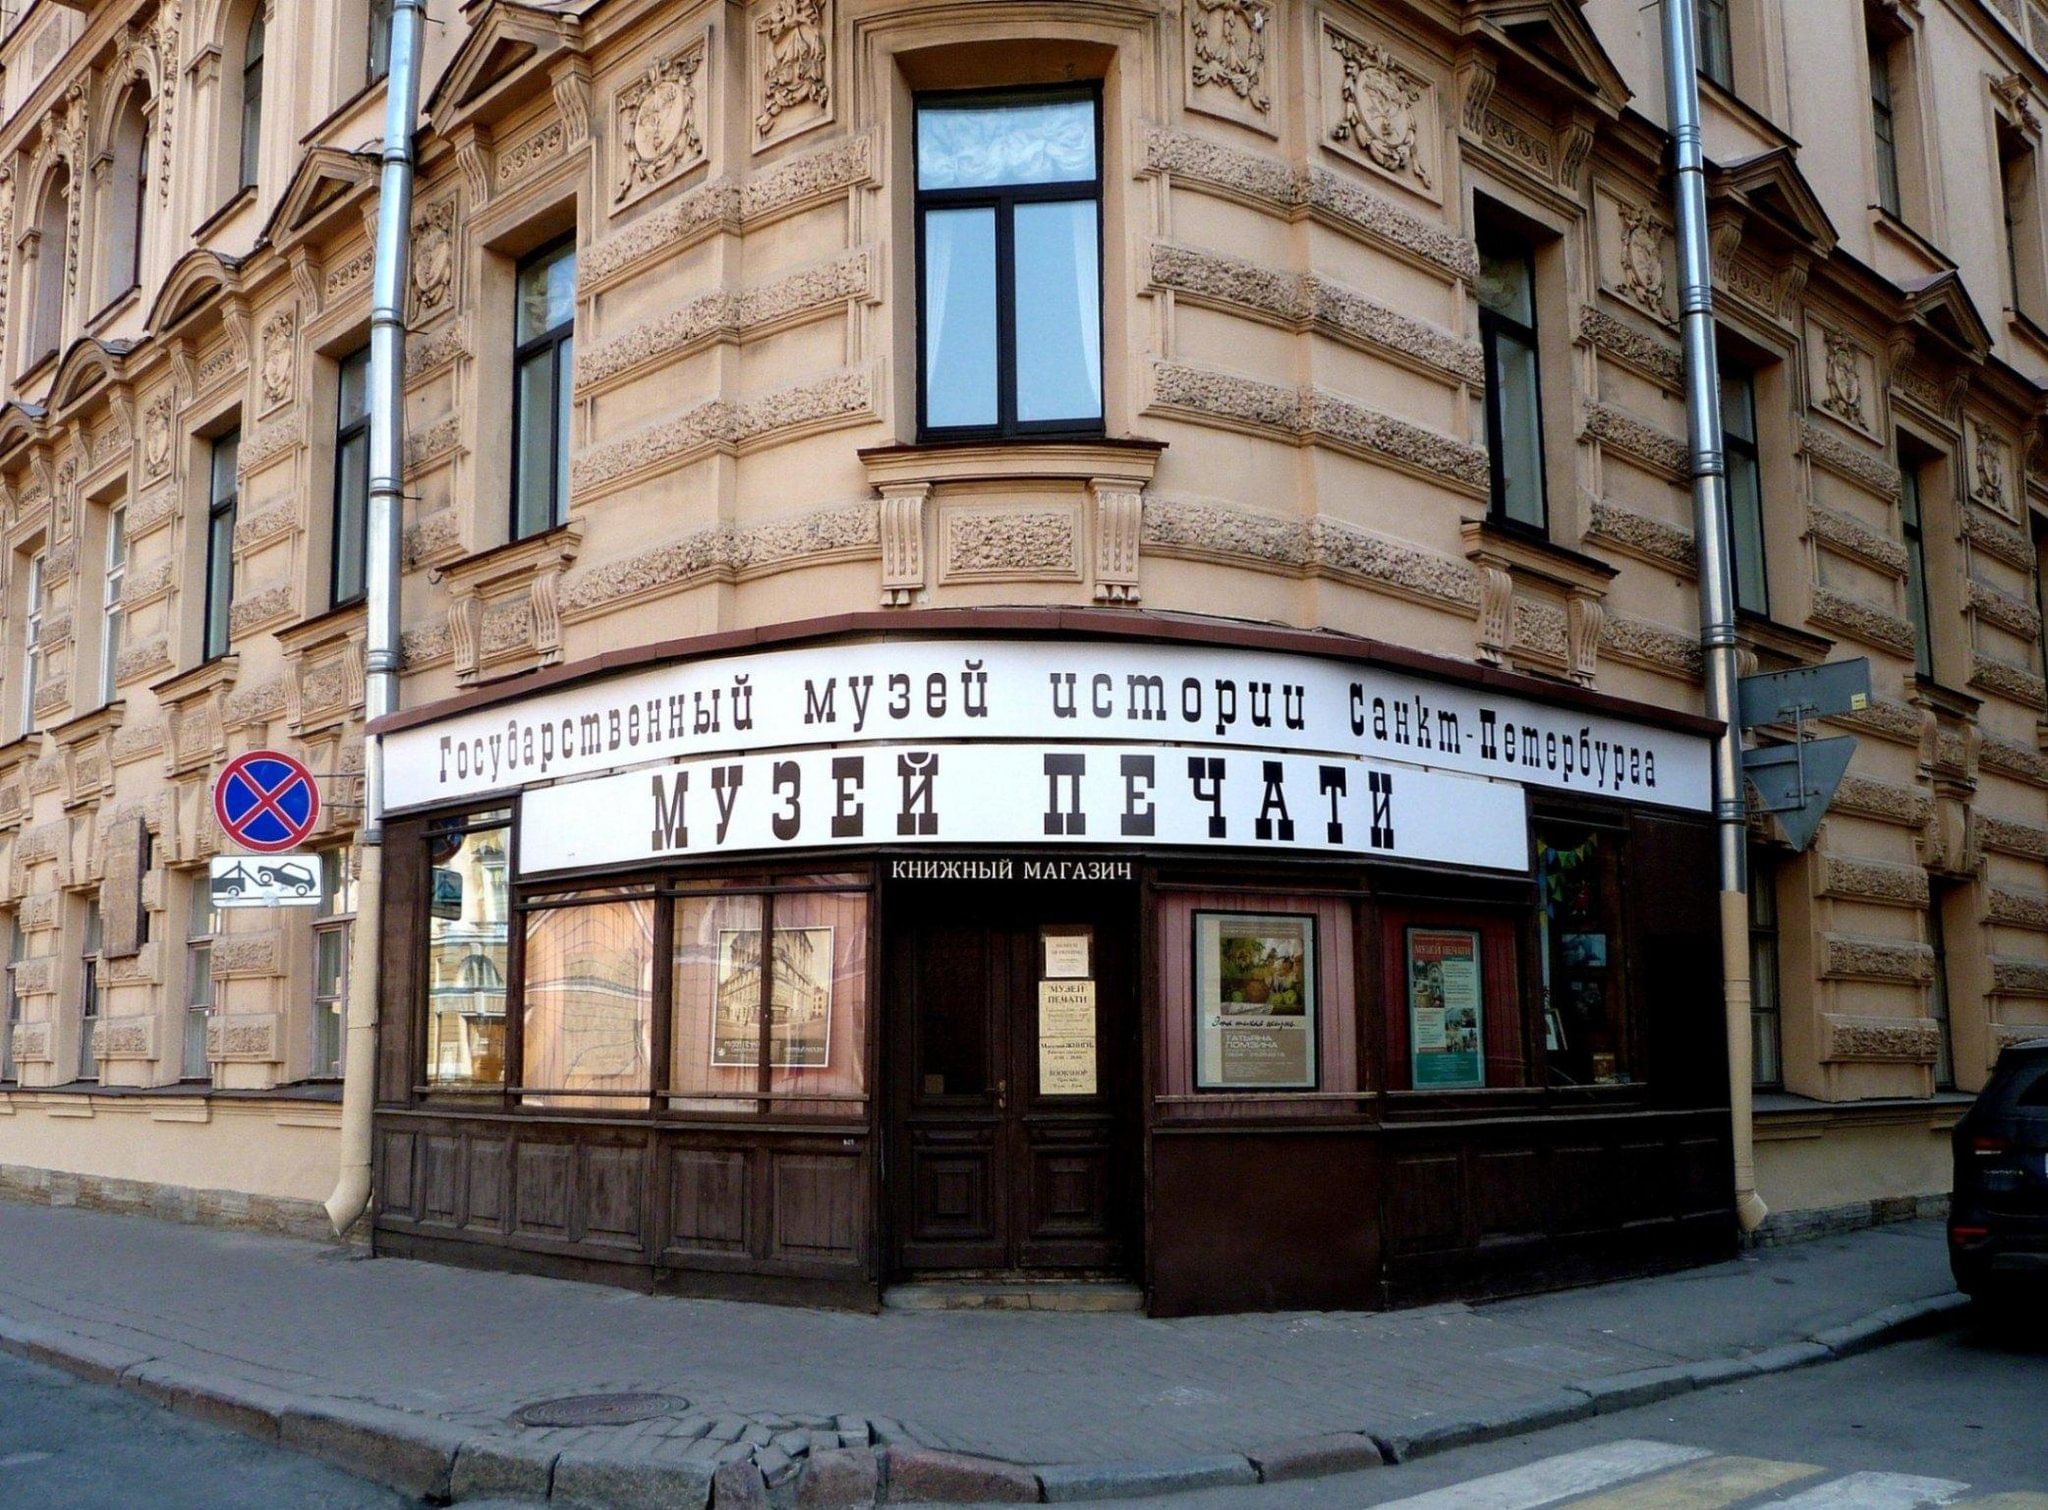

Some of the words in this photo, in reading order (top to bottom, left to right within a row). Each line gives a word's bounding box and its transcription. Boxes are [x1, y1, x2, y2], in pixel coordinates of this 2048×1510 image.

[439, 673, 753, 784] Государственный
[804, 659, 989, 734] музей
[1049, 671, 1306, 737] истории
[1349, 680, 1658, 793] Санкт-Петербурга
[651, 751, 940, 852] МУЗЕЙ
[1043, 753, 1396, 852] ПЕЧАТИ
[891, 858, 1014, 880] КНИЖНЫЙ
